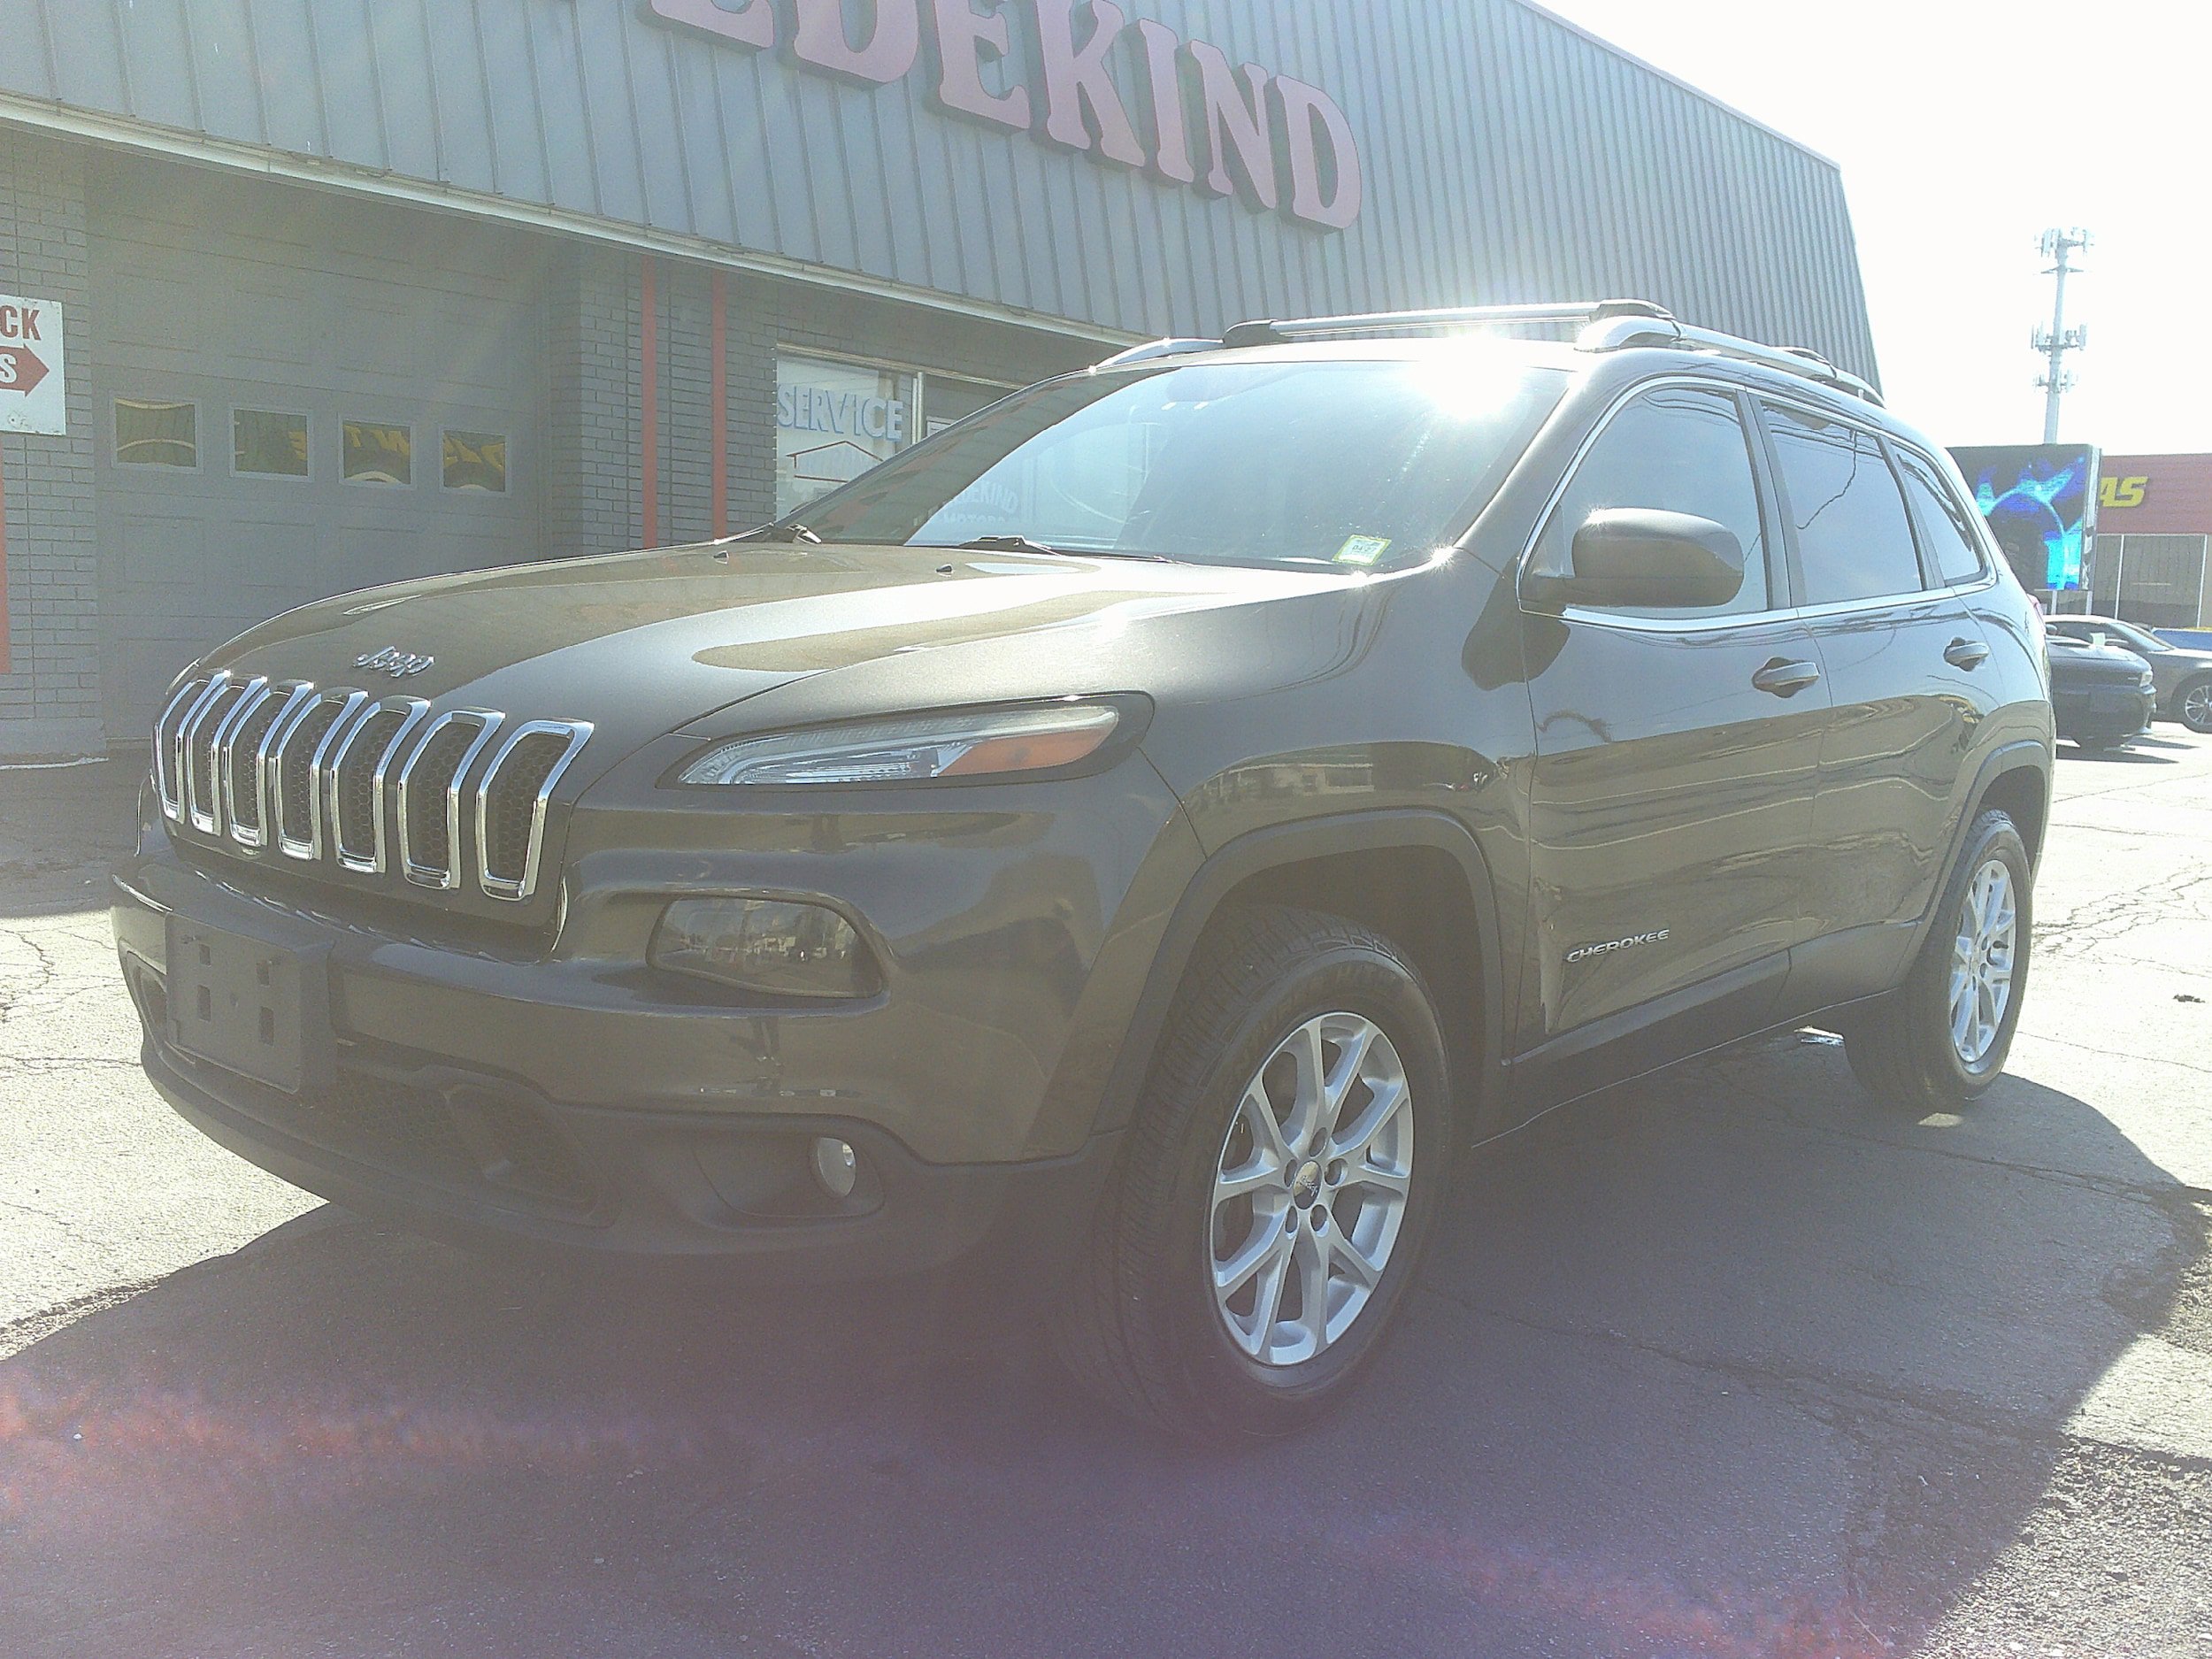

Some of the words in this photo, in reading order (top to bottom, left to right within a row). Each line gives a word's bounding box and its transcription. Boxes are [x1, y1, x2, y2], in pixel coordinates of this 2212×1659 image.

[778, 384, 903, 442] SERVICE
[352, 646, 434, 678] Jeep
[1566, 929, 1670, 963] CHEROKEE
